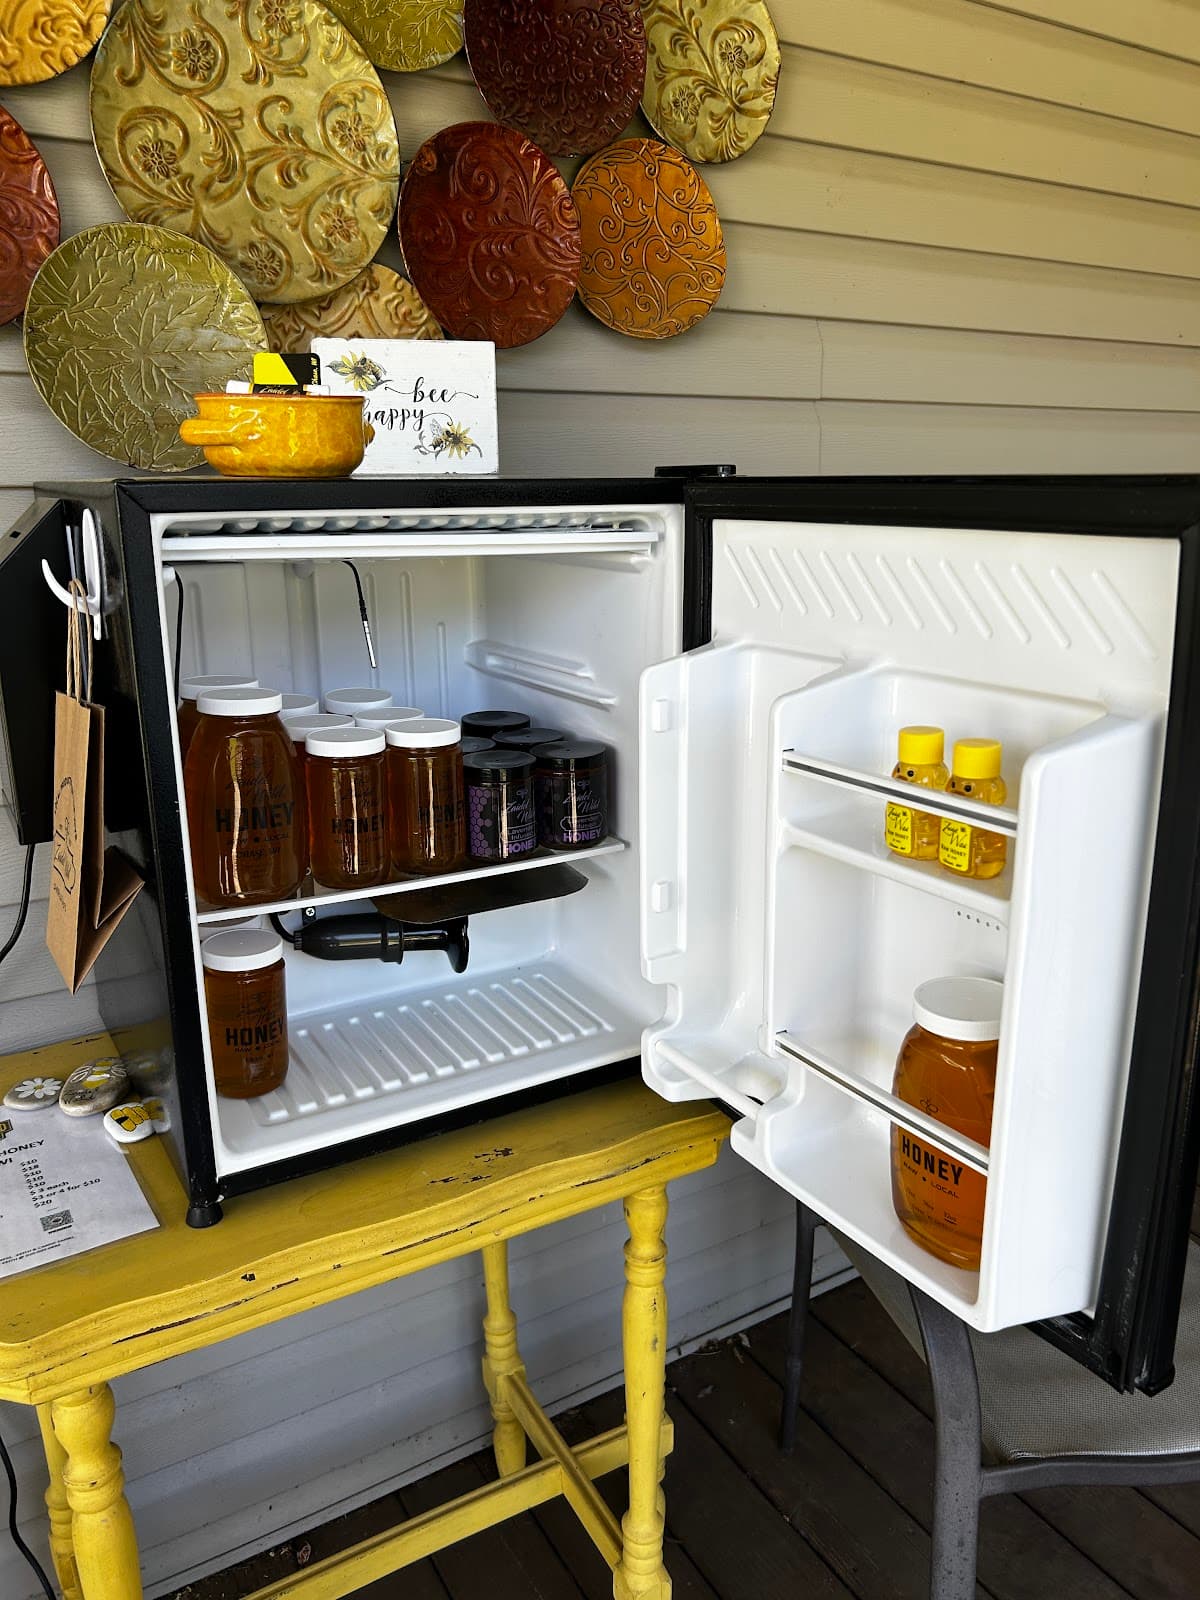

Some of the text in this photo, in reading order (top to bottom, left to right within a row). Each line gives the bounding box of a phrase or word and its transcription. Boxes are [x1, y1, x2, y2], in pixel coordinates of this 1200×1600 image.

[225, 1017, 284, 1047] HONEY
[20, 1158, 38, 1167] $10
[902, 1135, 964, 1186] HONEY
[24, 1170, 42, 1178] $10
[26, 1175, 44, 1184] $10
[28, 1181, 46, 1190] $10
[47, 1181, 70, 1190] each
[67, 1184, 81, 1192] for
[83, 1178, 101, 1187] $10
[930, 1181, 961, 1199] LOCAL
[34, 1199, 53, 1209] $20
